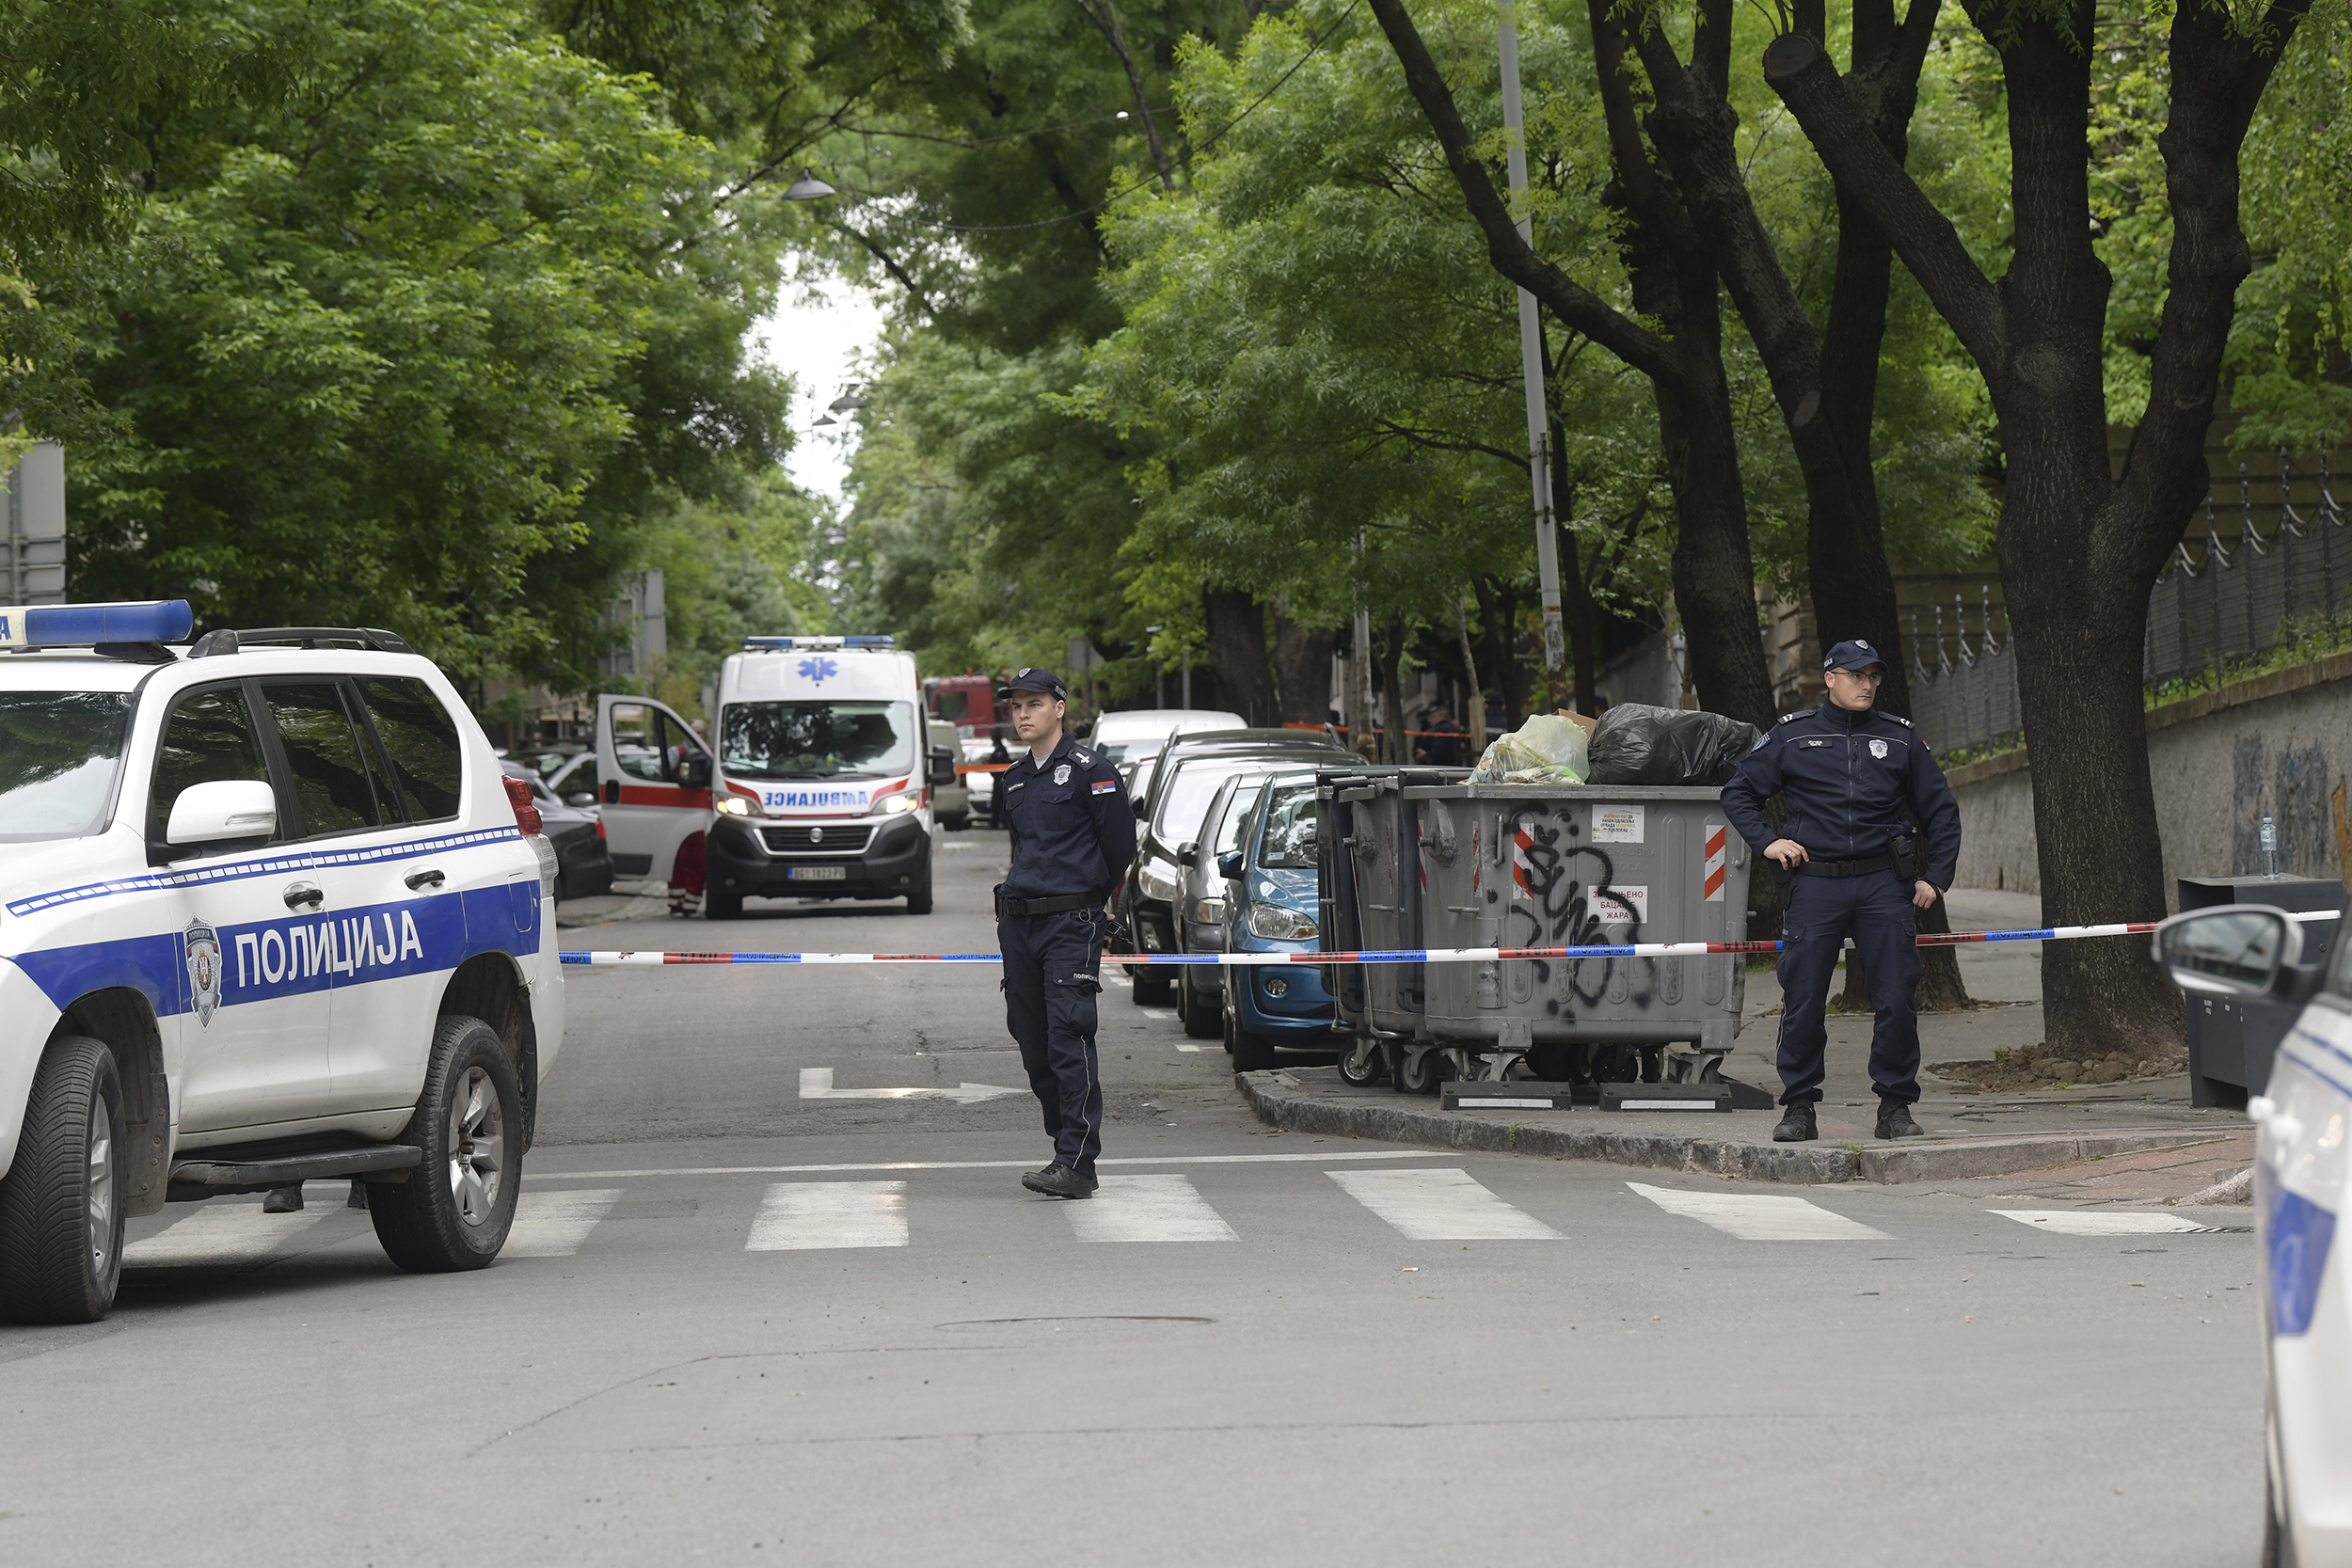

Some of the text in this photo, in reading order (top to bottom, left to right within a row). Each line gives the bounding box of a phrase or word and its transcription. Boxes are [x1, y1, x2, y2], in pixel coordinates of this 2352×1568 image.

[1605, 847, 1658, 857] GRADSKA
[1594, 876, 1645, 885] BEGRAD
[1600, 901, 1636, 910] БАЦАЕ
[235, 910, 423, 988] ПОЛИЦИЈА
